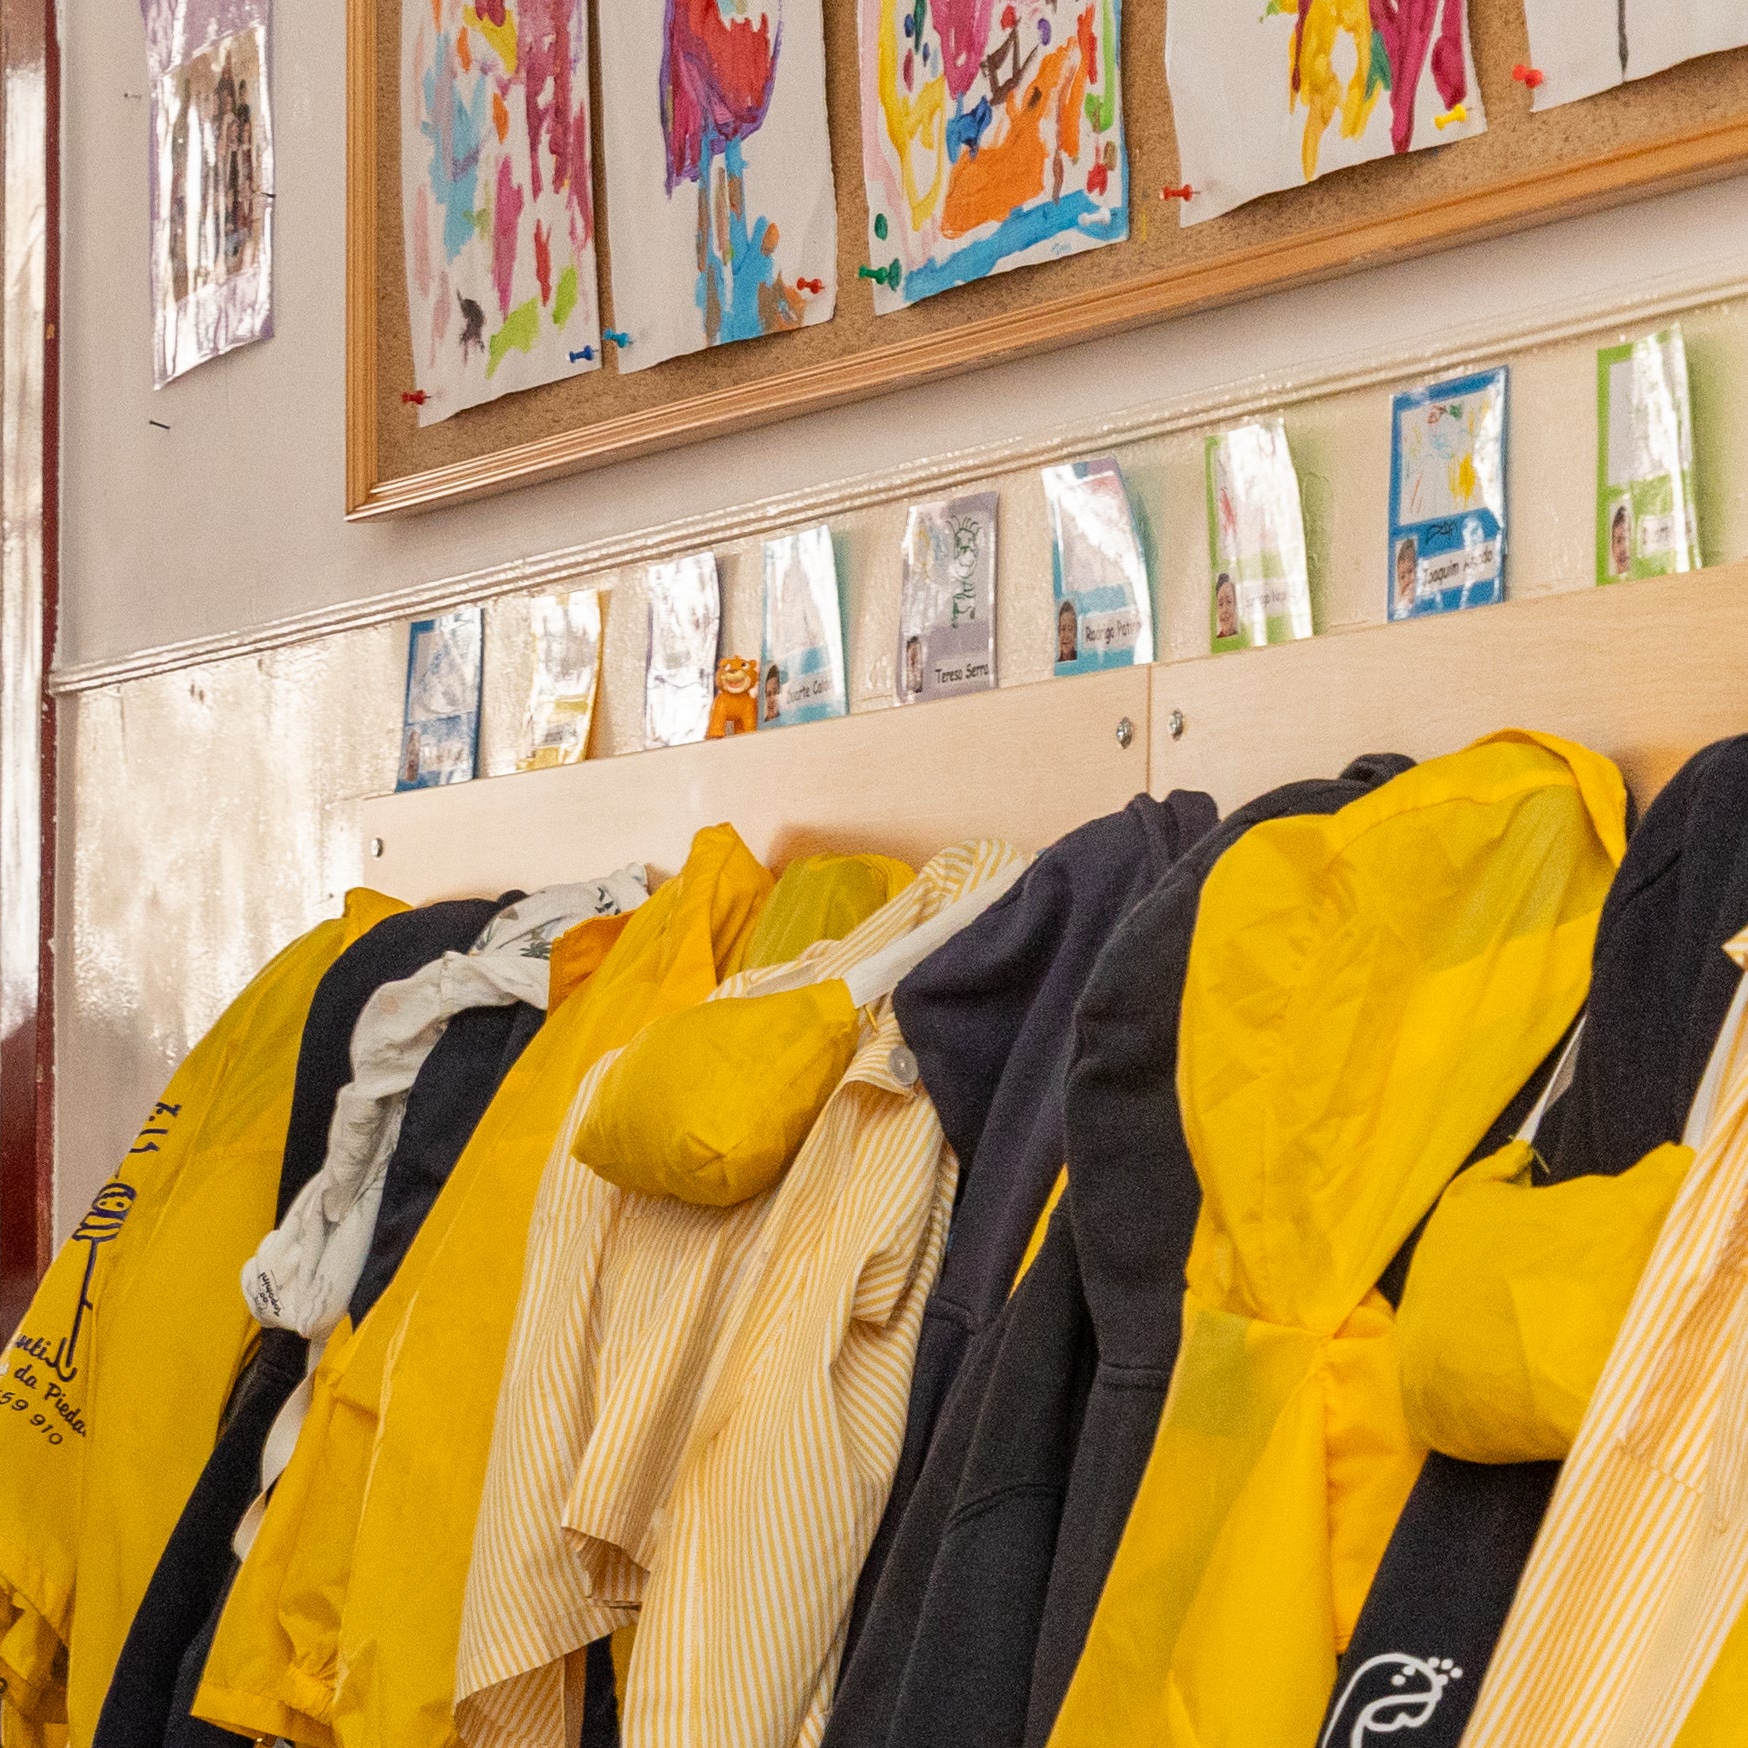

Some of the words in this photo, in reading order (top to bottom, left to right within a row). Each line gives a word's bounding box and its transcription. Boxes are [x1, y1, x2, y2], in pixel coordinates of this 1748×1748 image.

[934, 667, 963, 684] Teresa
[965, 662, 989, 679] Serra
[13, 1363, 39, 1390] da
[44, 1382, 87, 1438] Pieda
[29, 1413, 64, 1446] 910
